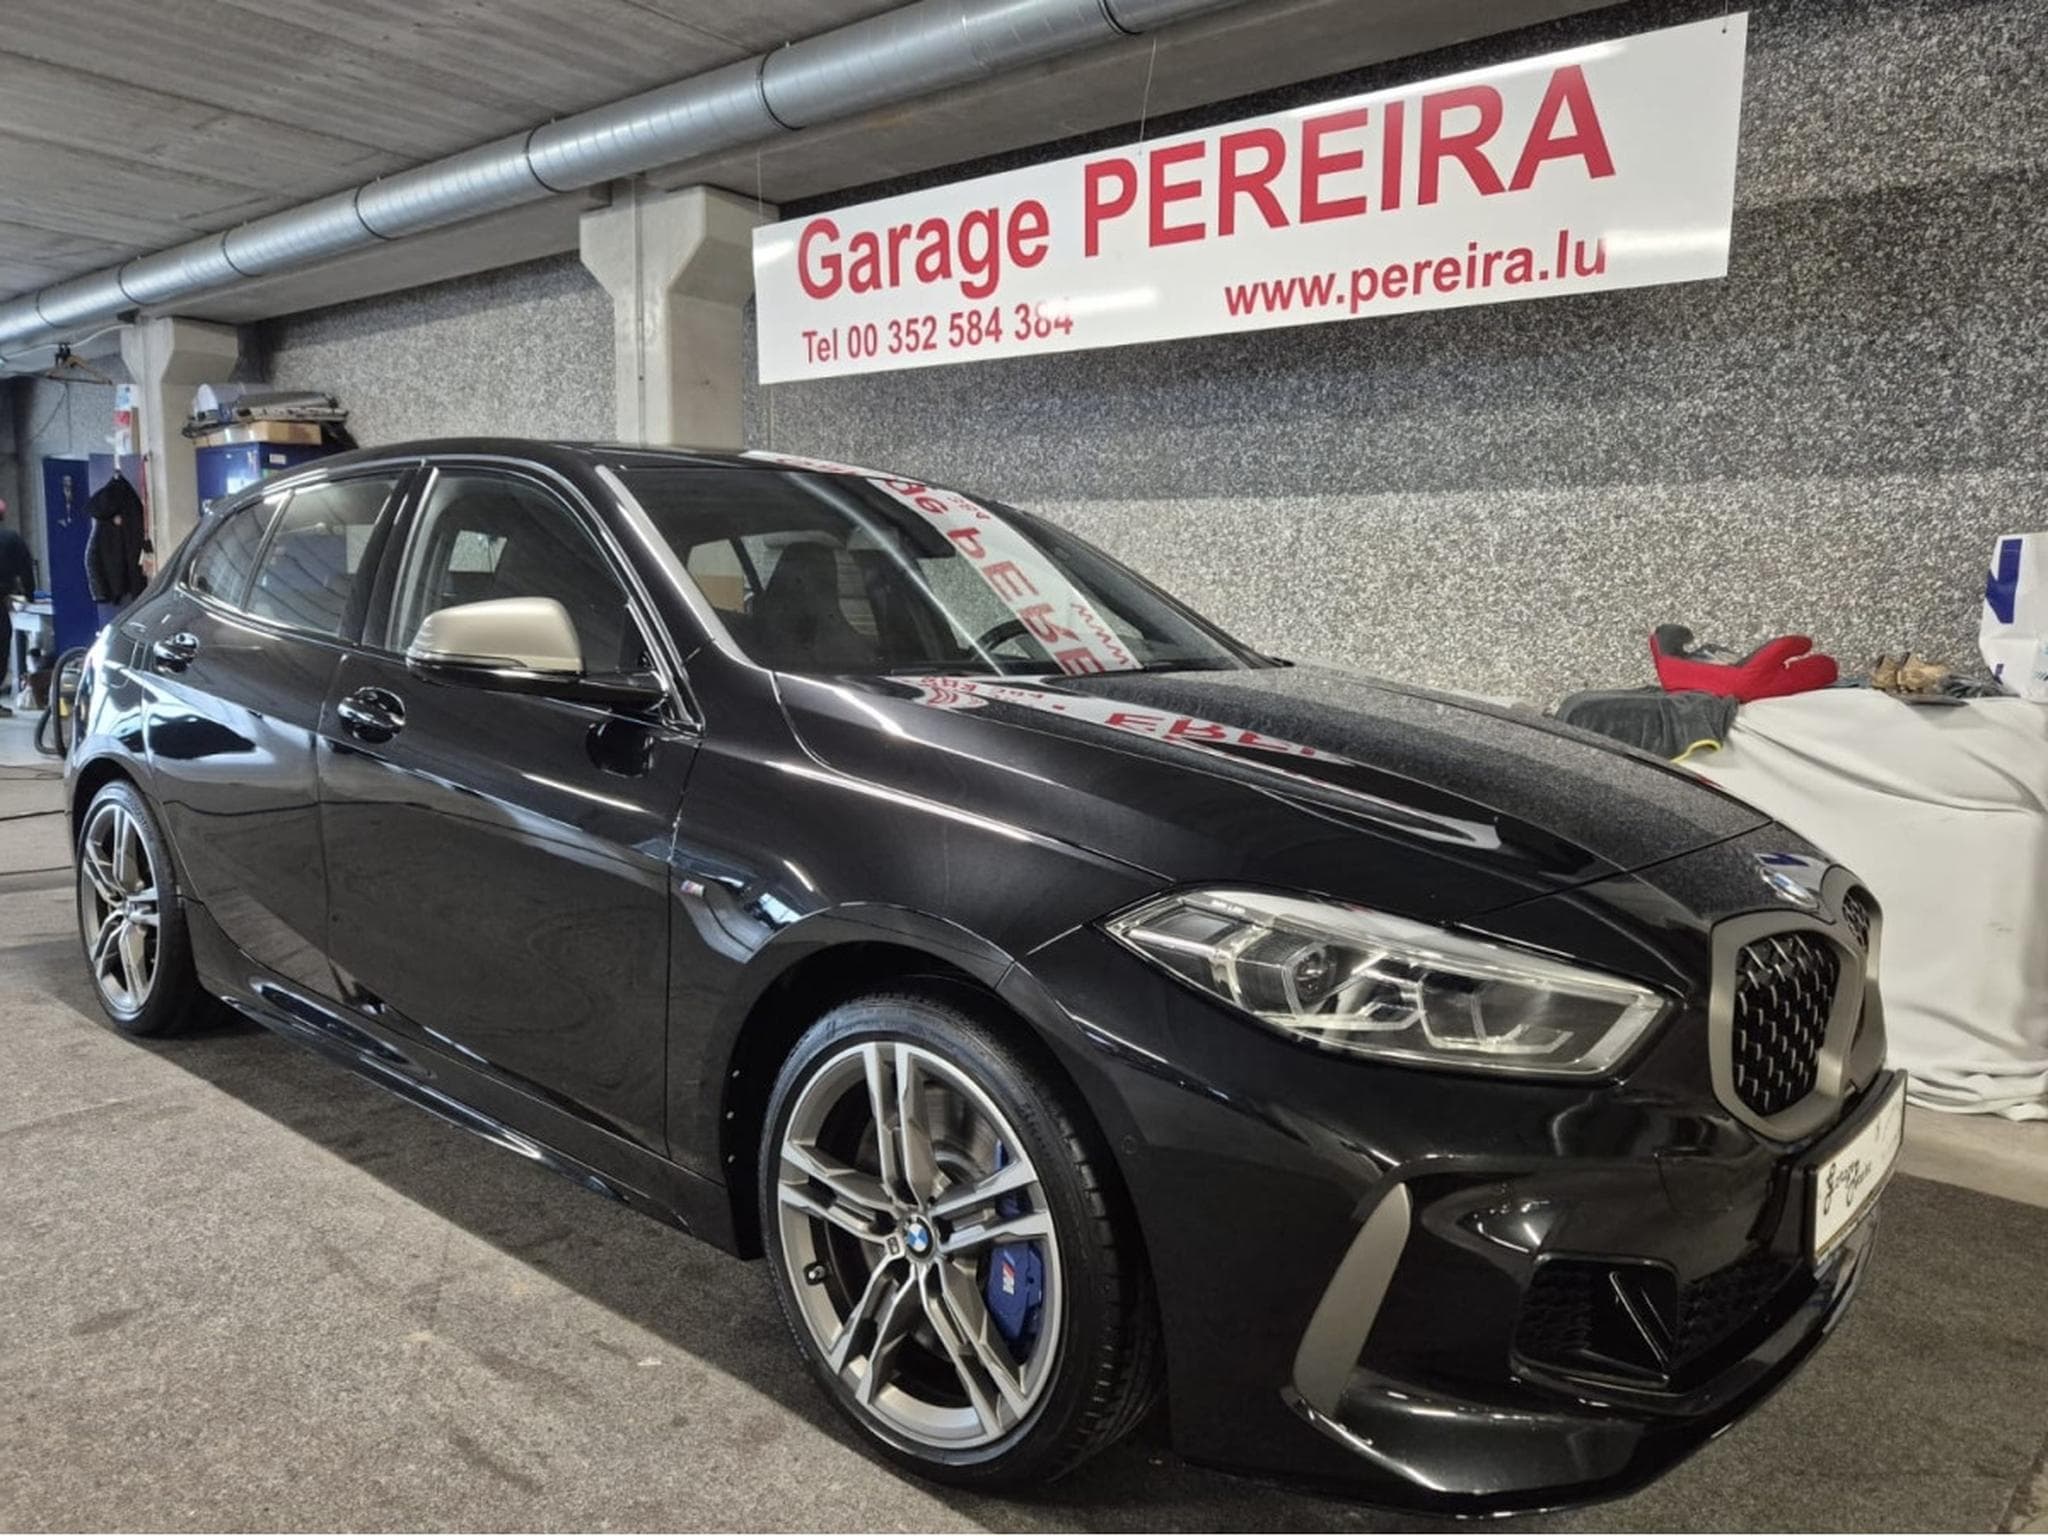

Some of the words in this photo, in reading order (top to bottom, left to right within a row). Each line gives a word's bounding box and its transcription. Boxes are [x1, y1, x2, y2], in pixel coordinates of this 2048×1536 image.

[796, 198, 1053, 302] Garage
[1082, 64, 1617, 259] PEREIRA
[1224, 229, 1609, 319] www.pereira.lu
[802, 328, 838, 364] Tel
[847, 323, 879, 359] 00
[888, 315, 938, 354] 352
[948, 309, 1003, 348] 584
